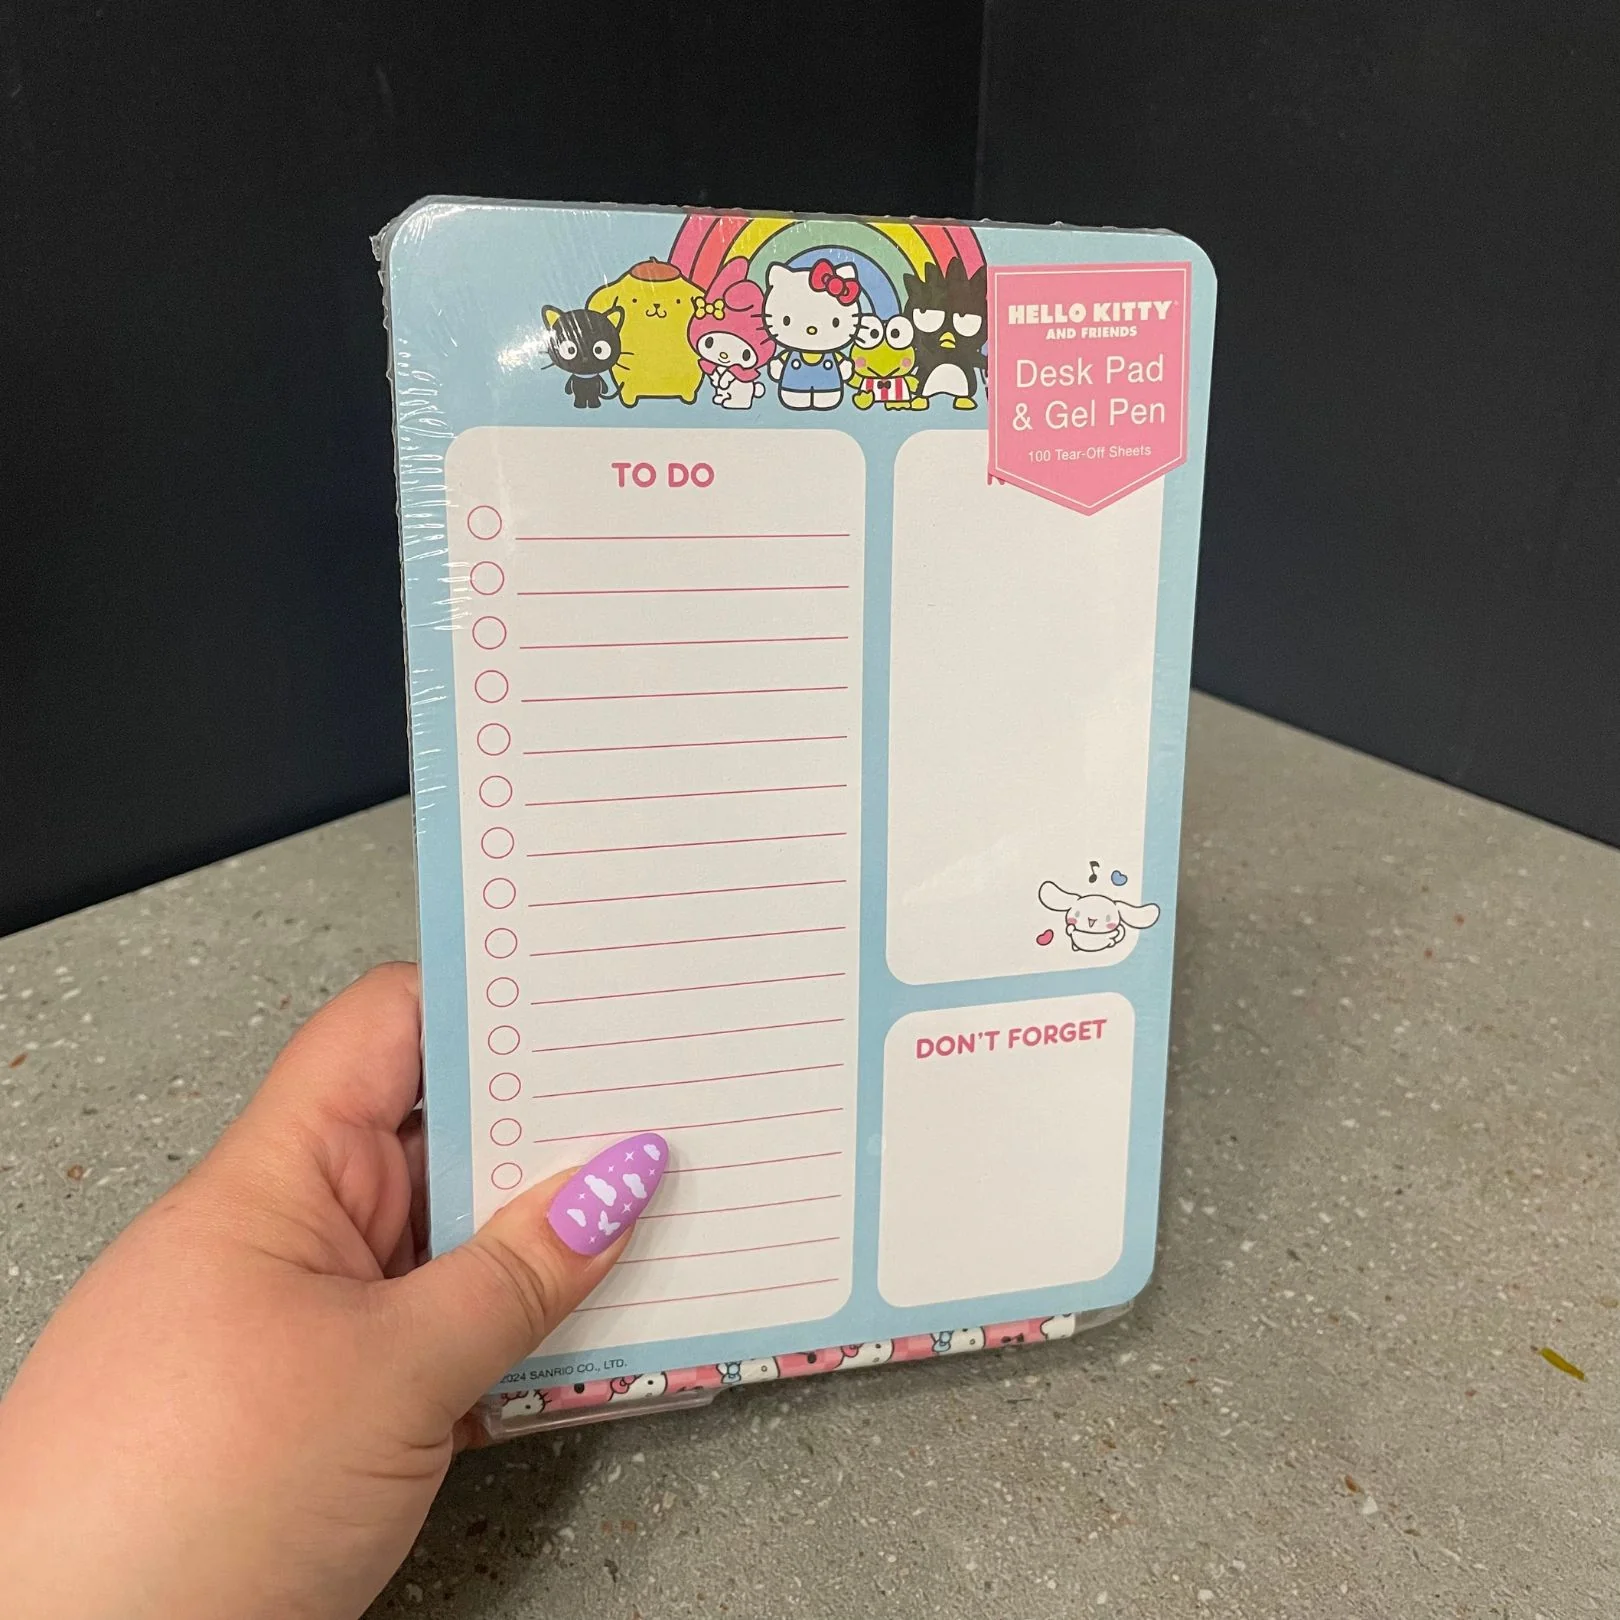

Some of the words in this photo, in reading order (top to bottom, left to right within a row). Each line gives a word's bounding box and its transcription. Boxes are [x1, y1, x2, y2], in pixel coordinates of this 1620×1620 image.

[1008, 303, 1087, 325] HELLO
[1093, 300, 1173, 322] KITTY
[1045, 327, 1077, 340] AND
[1081, 326, 1138, 339] FRIENDS
[1016, 357, 1094, 388] Desk
[1106, 353, 1164, 384] Pad
[1012, 402, 1033, 431] &
[1045, 399, 1096, 430] Gel
[1109, 398, 1165, 426] Pen
[1028, 450, 1051, 463] 100
[1055, 446, 1105, 461] Tear-Off
[1108, 445, 1152, 458] Sheets
[611, 462, 657, 488] TO
[668, 462, 715, 488] DO
[916, 1030, 1001, 1059] DON'T
[1008, 1019, 1107, 1049] FORGET
[529, 1365, 574, 1380] SANRIO
[576, 1362, 601, 1373] CO.,
[604, 1358, 628, 1370] LTD.
